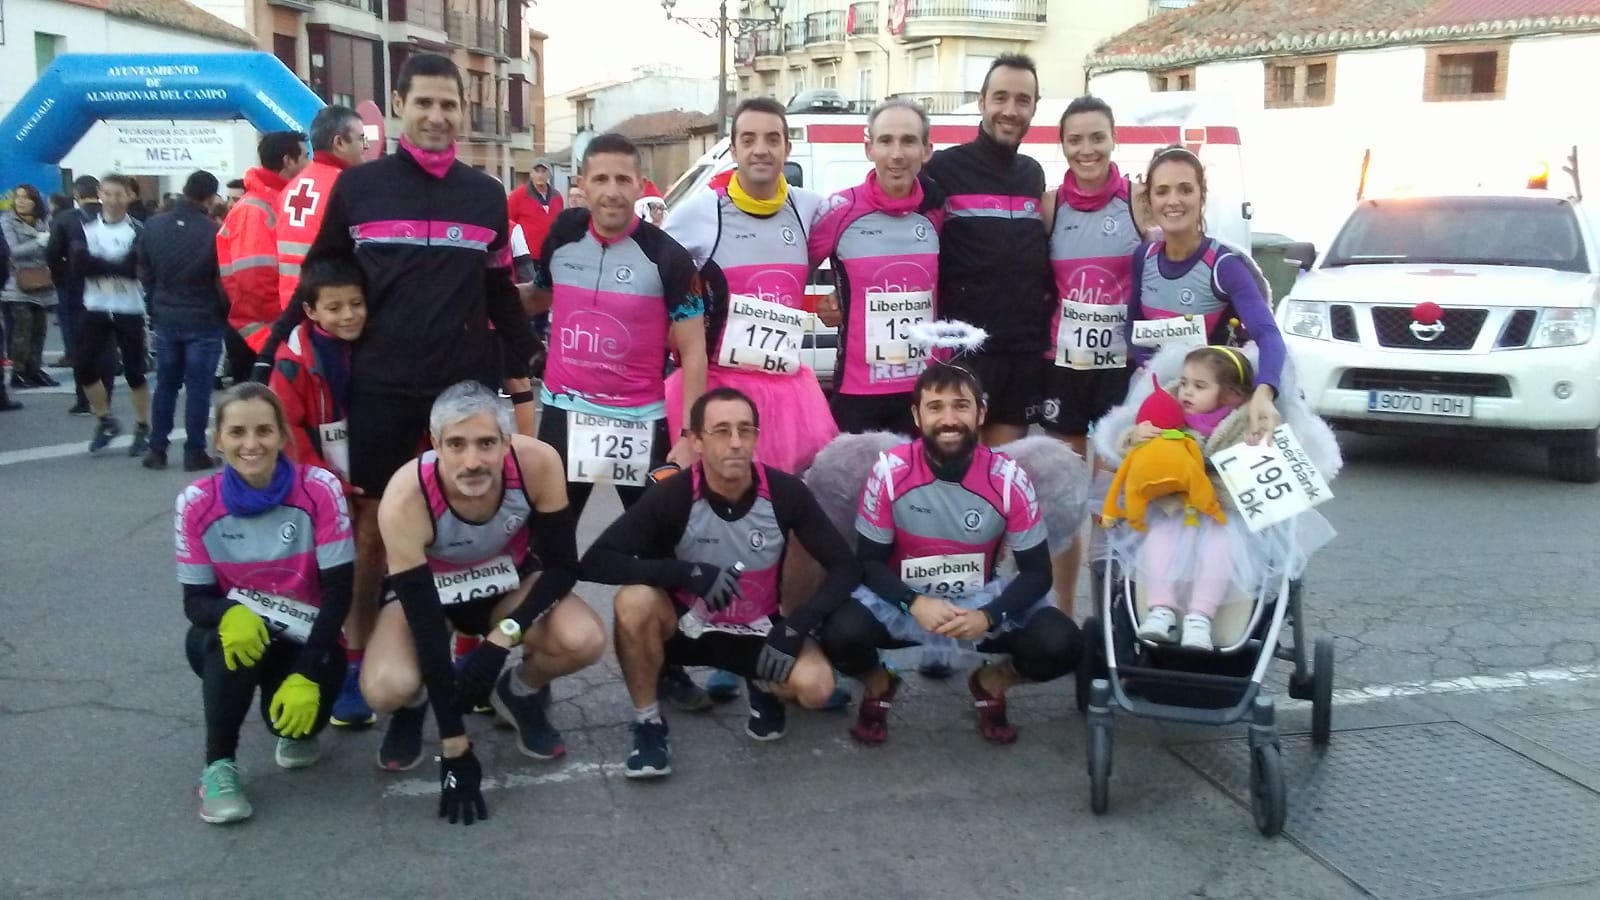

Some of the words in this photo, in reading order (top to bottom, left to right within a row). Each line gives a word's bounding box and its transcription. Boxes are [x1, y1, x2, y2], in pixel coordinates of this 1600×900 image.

[107, 65, 199, 77] AYUNTAMIENTO
[145, 78, 161, 88] DE
[160, 90, 183, 100] DEL
[184, 88, 227, 100] CAMPO
[191, 136, 224, 145] CAMPO
[146, 147, 193, 161] META
[733, 302, 803, 327] Liberbank
[1063, 306, 1127, 323] Liberbank
[746, 324, 788, 352] 177
[1074, 327, 1112, 349] 160
[1135, 322, 1201, 339] Liberbank
[729, 348, 739, 365] L
[763, 355, 790, 373] bk
[876, 345, 886, 361] L
[1064, 349, 1072, 364] L
[1094, 351, 1117, 366] bk
[1381, 393, 1423, 411] 9070
[1430, 397, 1465, 413] HDH
[591, 433, 634, 460] 125
[577, 460, 588, 478] L
[613, 462, 639, 481] bk
[1273, 429, 1321, 501] Liberbank
[1220, 456, 1237, 471] L
[1238, 488, 1265, 519] bk
[1249, 455, 1293, 501] 195
[906, 560, 981, 579] Liberbank
